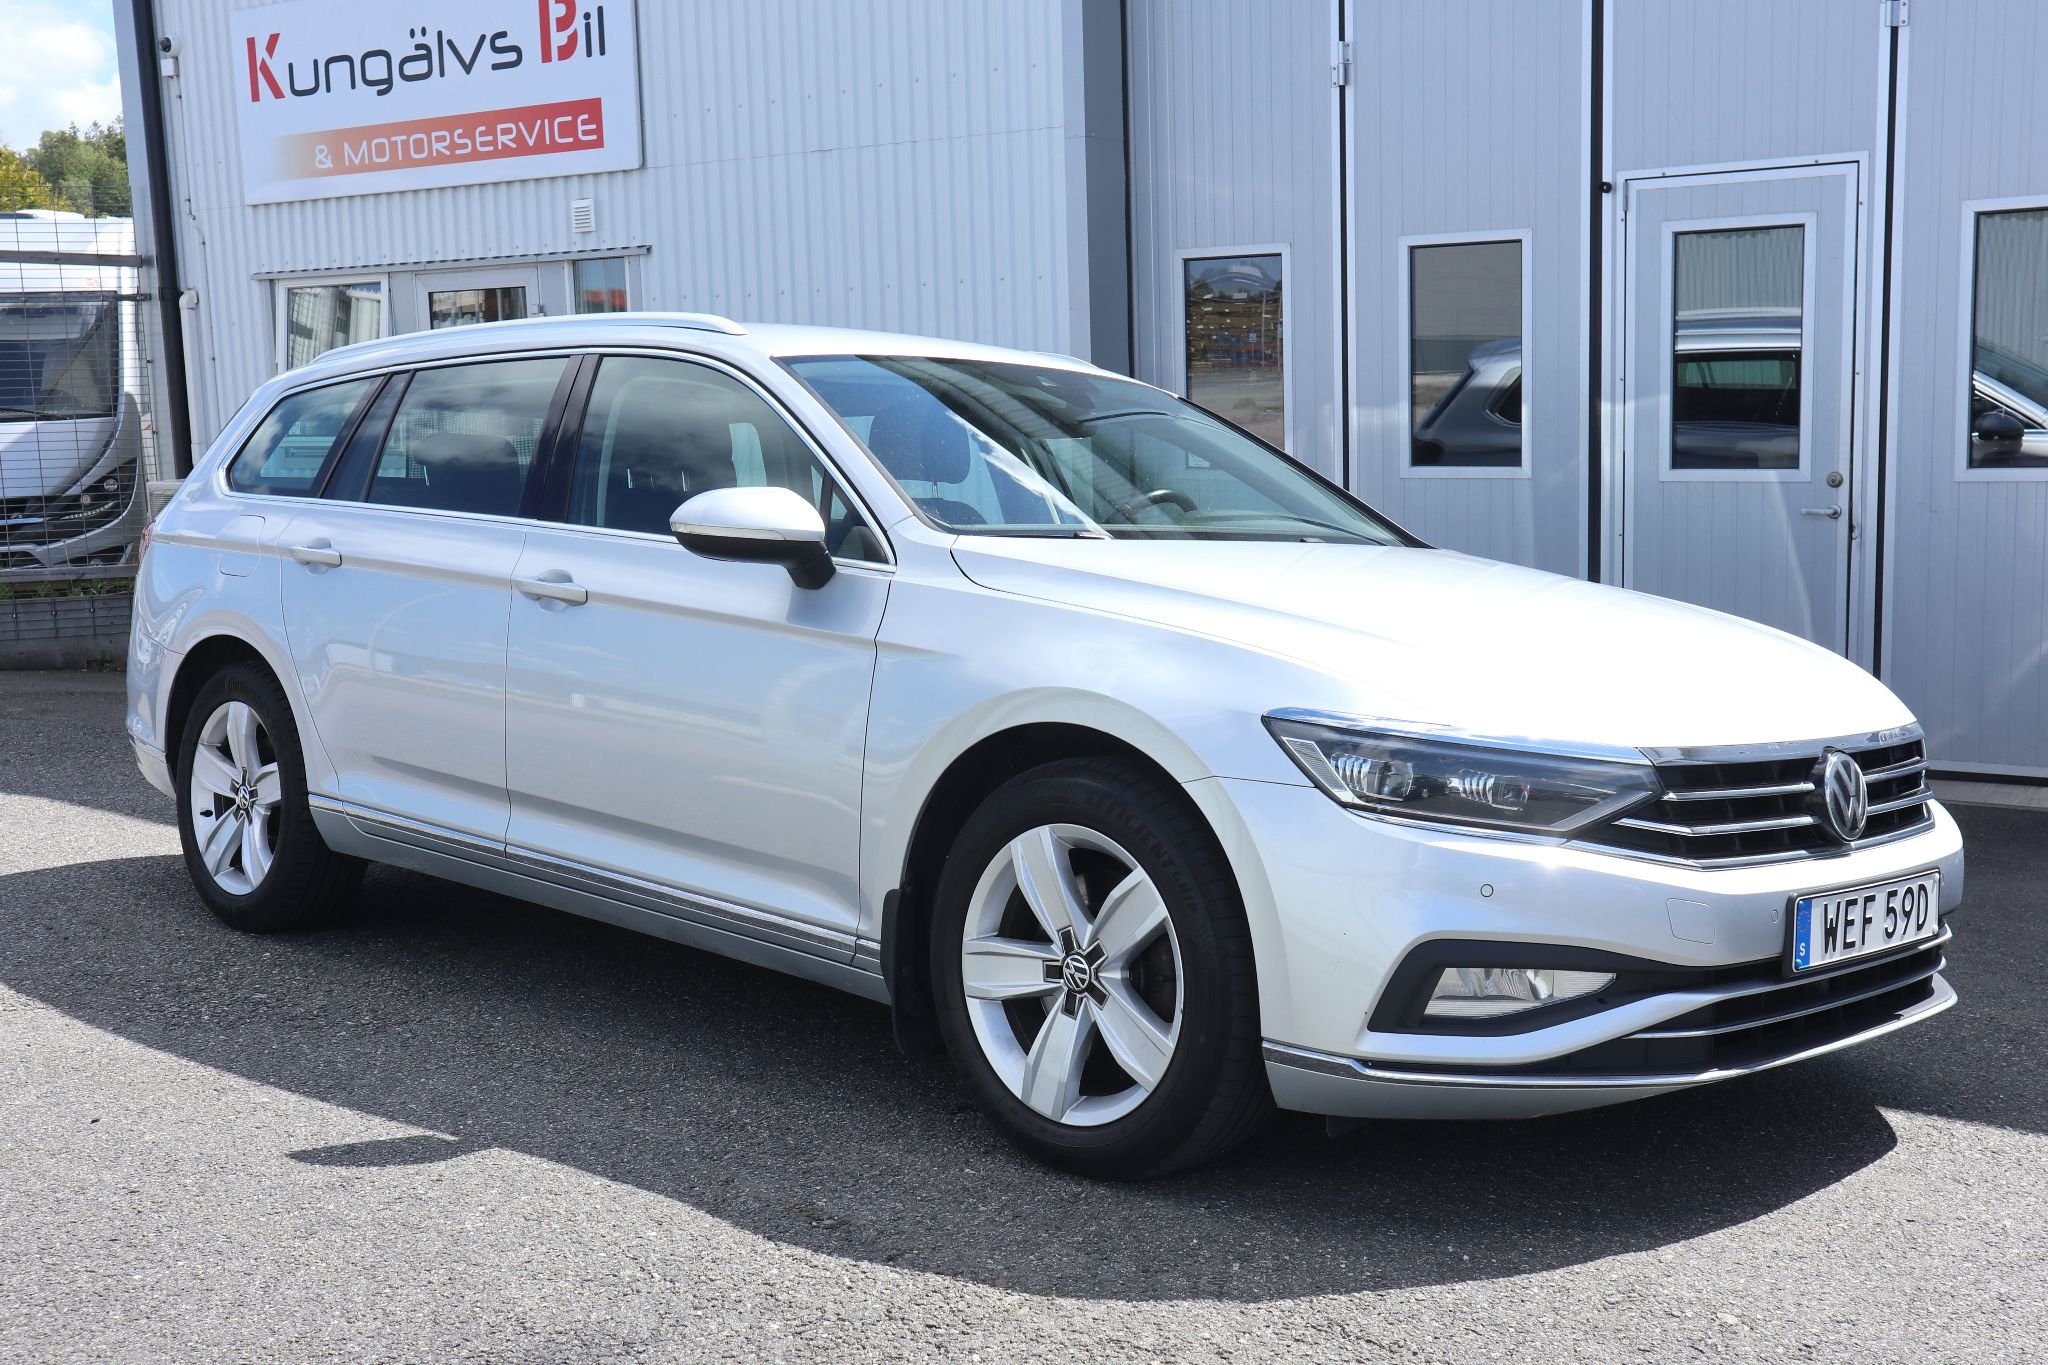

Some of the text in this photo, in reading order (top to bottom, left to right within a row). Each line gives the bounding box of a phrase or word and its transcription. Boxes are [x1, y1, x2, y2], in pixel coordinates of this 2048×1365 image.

[246, 0, 606, 103] Kungälvs Bil
[314, 113, 598, 169] & MOTORSERVICE
[1799, 942, 1806, 957] S
[1823, 883, 1929, 955] WEF 59D
